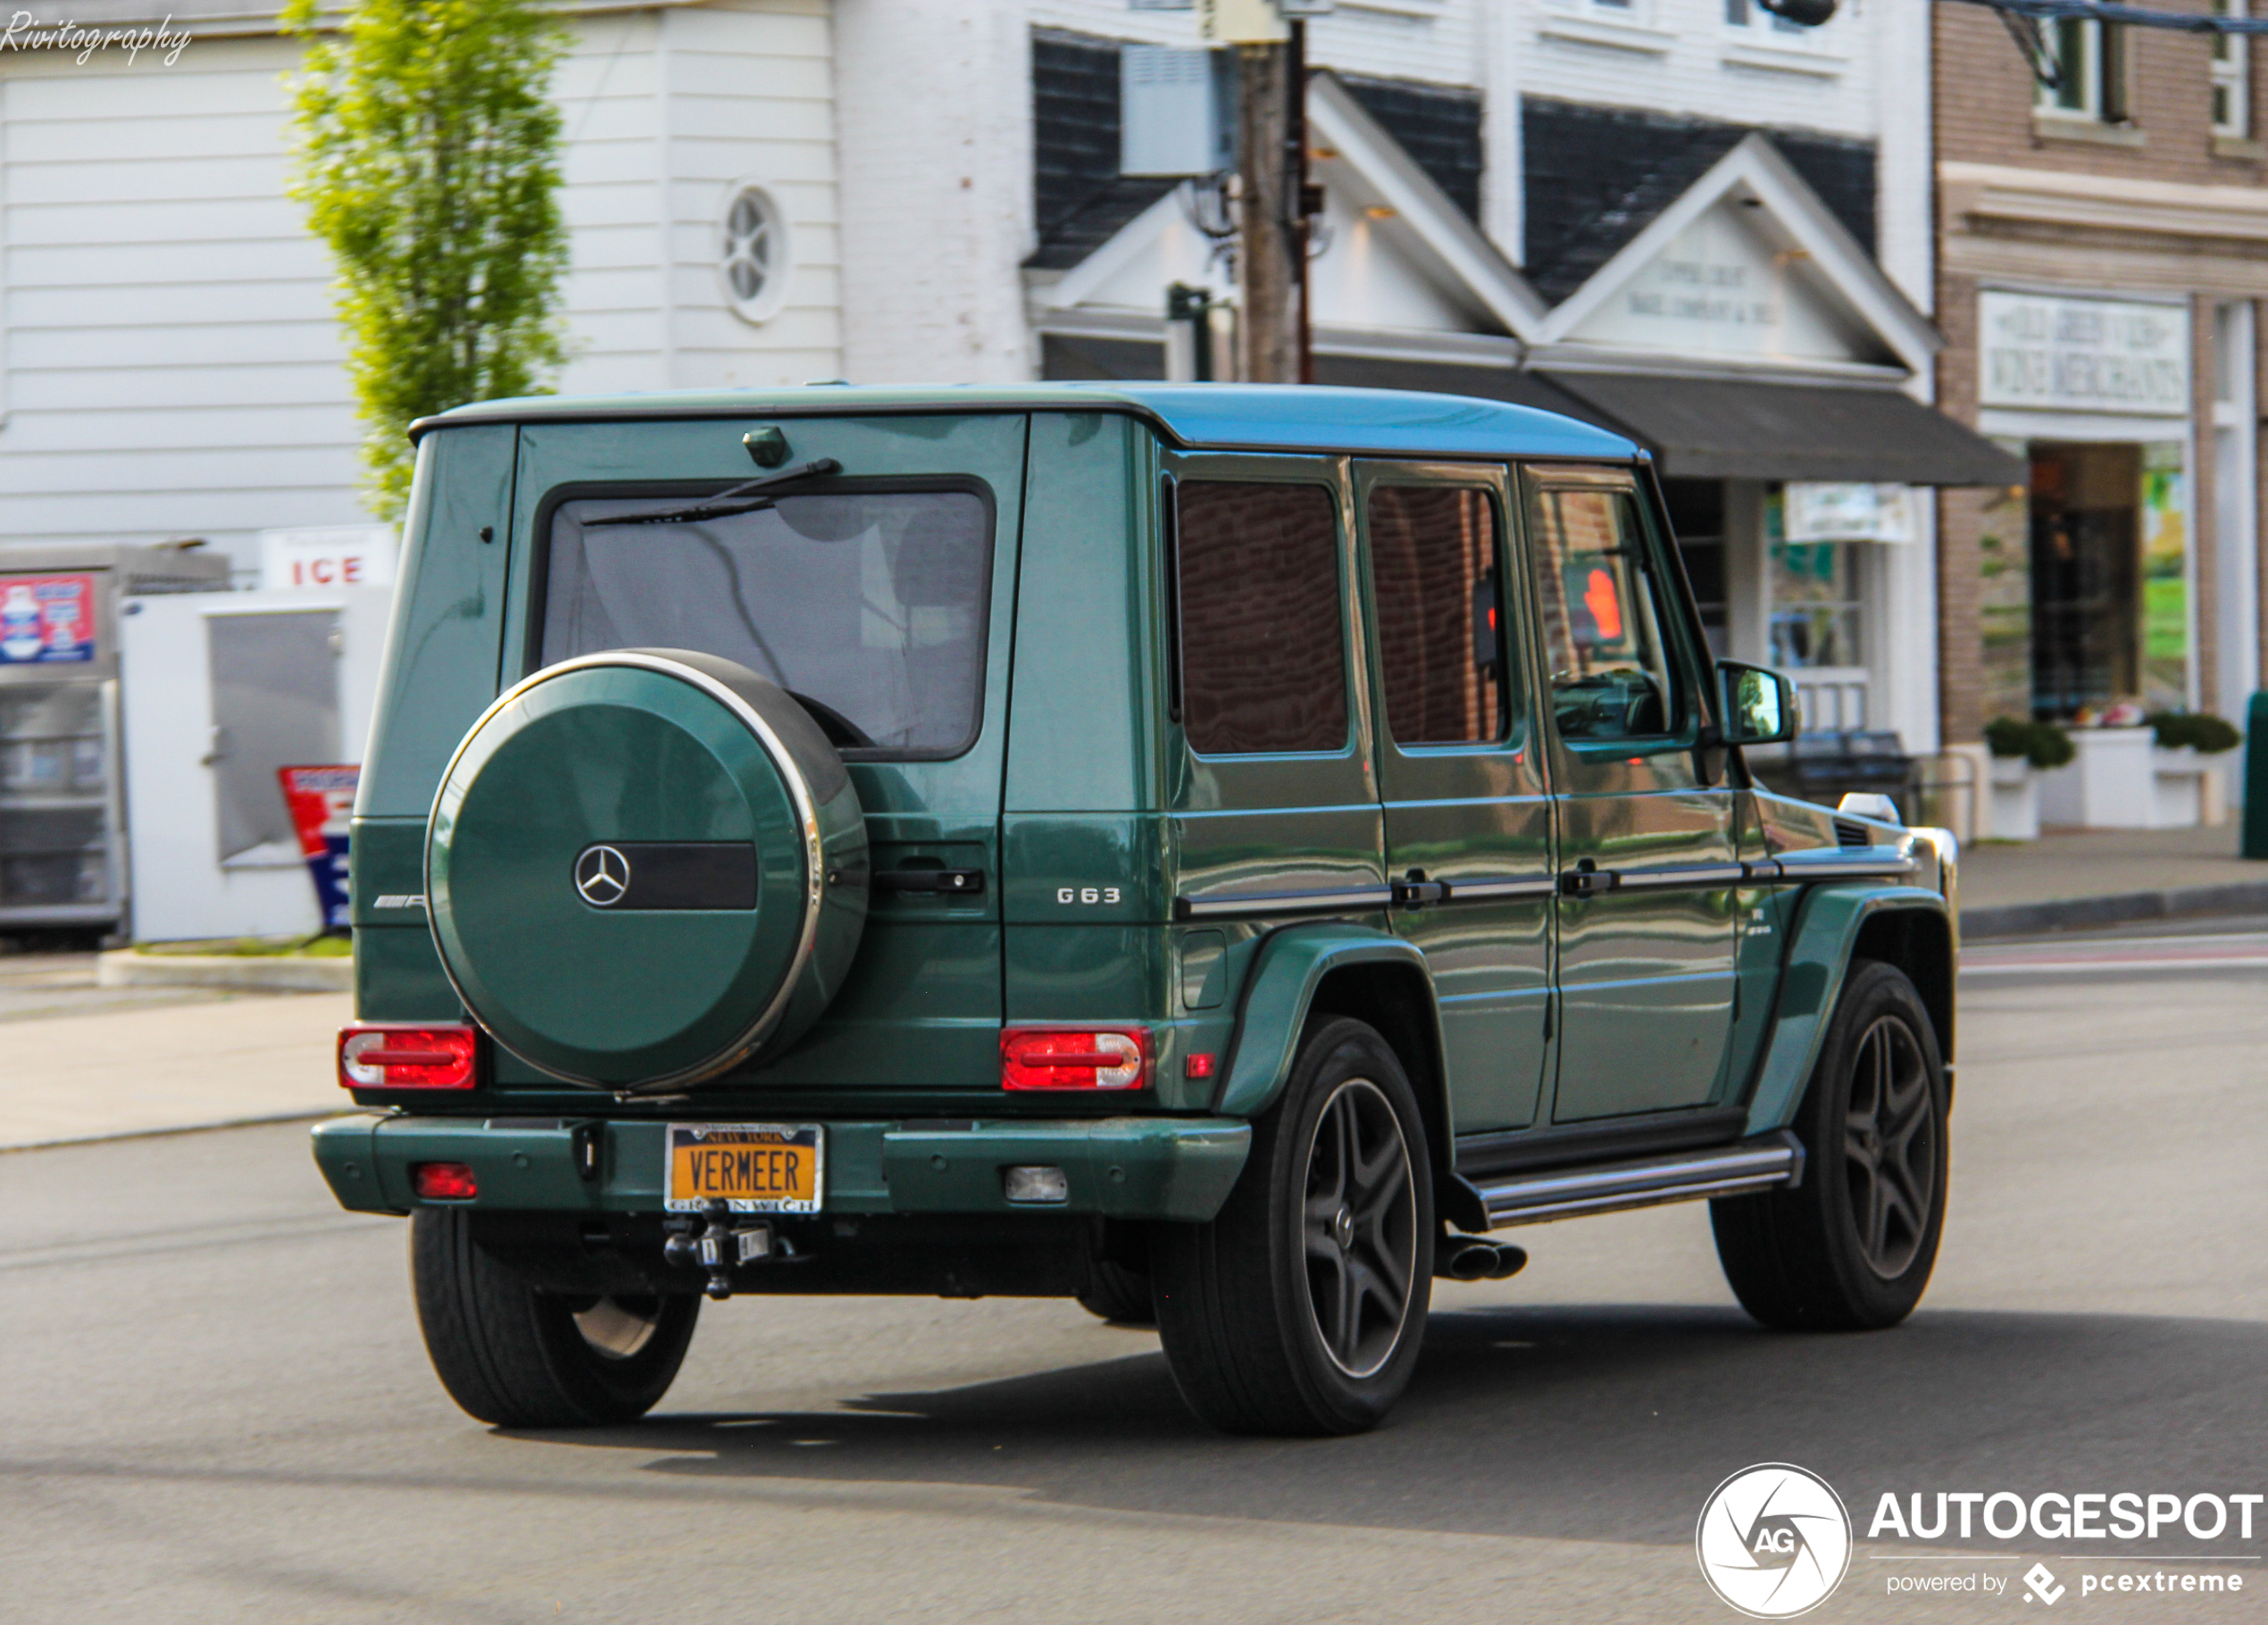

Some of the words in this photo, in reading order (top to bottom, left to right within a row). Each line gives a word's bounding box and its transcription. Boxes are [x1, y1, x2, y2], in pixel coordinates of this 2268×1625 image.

[292, 556, 363, 585] ICE
[690, 1151, 799, 1192] VERMEER
[671, 1200, 814, 1212] GRNWICH
